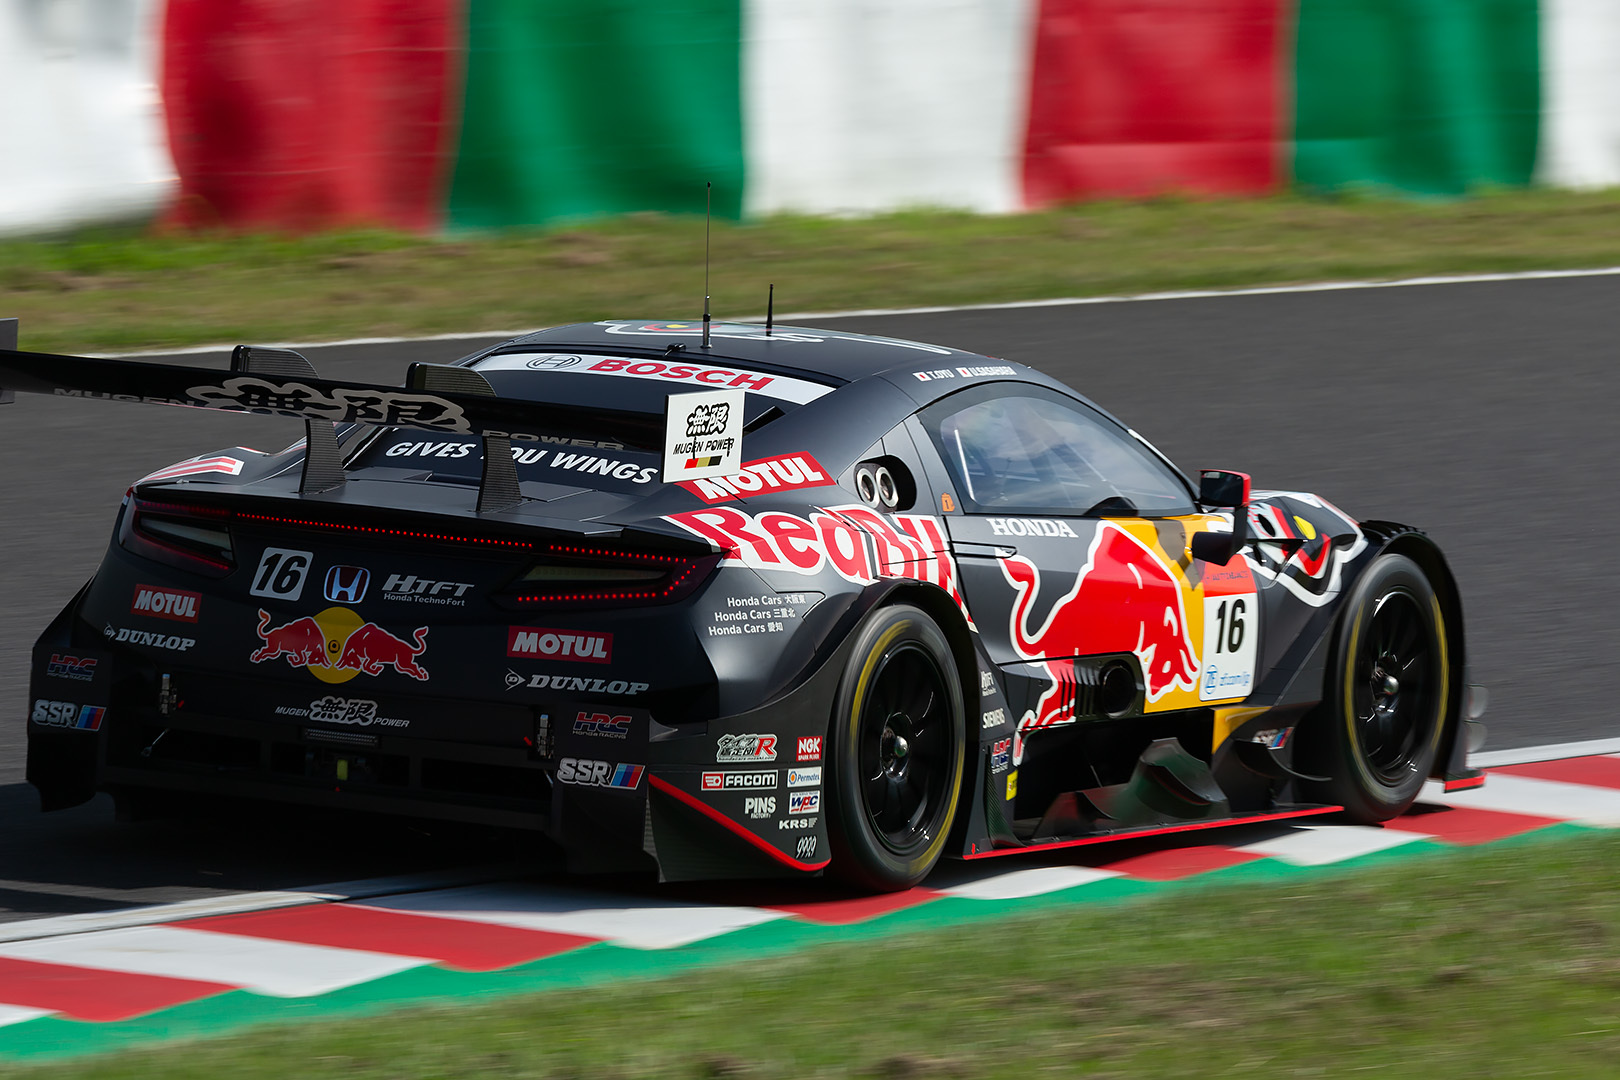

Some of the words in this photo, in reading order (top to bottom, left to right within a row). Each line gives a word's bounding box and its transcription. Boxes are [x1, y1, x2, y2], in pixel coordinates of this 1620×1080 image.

[587, 359, 775, 390] BOSCH
[686, 402, 730, 437] 無限
[482, 430, 625, 451] POWER
[673, 441, 704, 455] MUGEN
[705, 438, 735, 452] POWER
[385, 442, 477, 459] GIVES
[550, 453, 659, 484] WINGS
[986, 518, 1079, 538] HONDA
[662, 507, 873, 584] Red
[256, 553, 307, 594] 16
[134, 590, 197, 618] MOTUL
[383, 593, 412, 602] Honda
[727, 596, 759, 607] Honda
[761, 595, 782, 605] Cars
[714, 611, 748, 622] Honda
[749, 609, 772, 619] Cars
[1216, 598, 1246, 654] 16
[115, 628, 197, 651] DUNLOP
[708, 625, 742, 636] Honda
[743, 623, 766, 633] Cars
[511, 631, 608, 659] MOTUL
[526, 674, 650, 695] DUNLOP
[31, 700, 78, 729] SSR
[273, 706, 310, 718] MUGEN
[308, 696, 379, 727] 無限
[373, 717, 411, 728] POWER
[573, 712, 632, 734] HRC
[798, 737, 822, 754] NGK
[557, 758, 612, 787] SSR
[725, 773, 776, 787] FACOM
[744, 796, 776, 815] PINS
